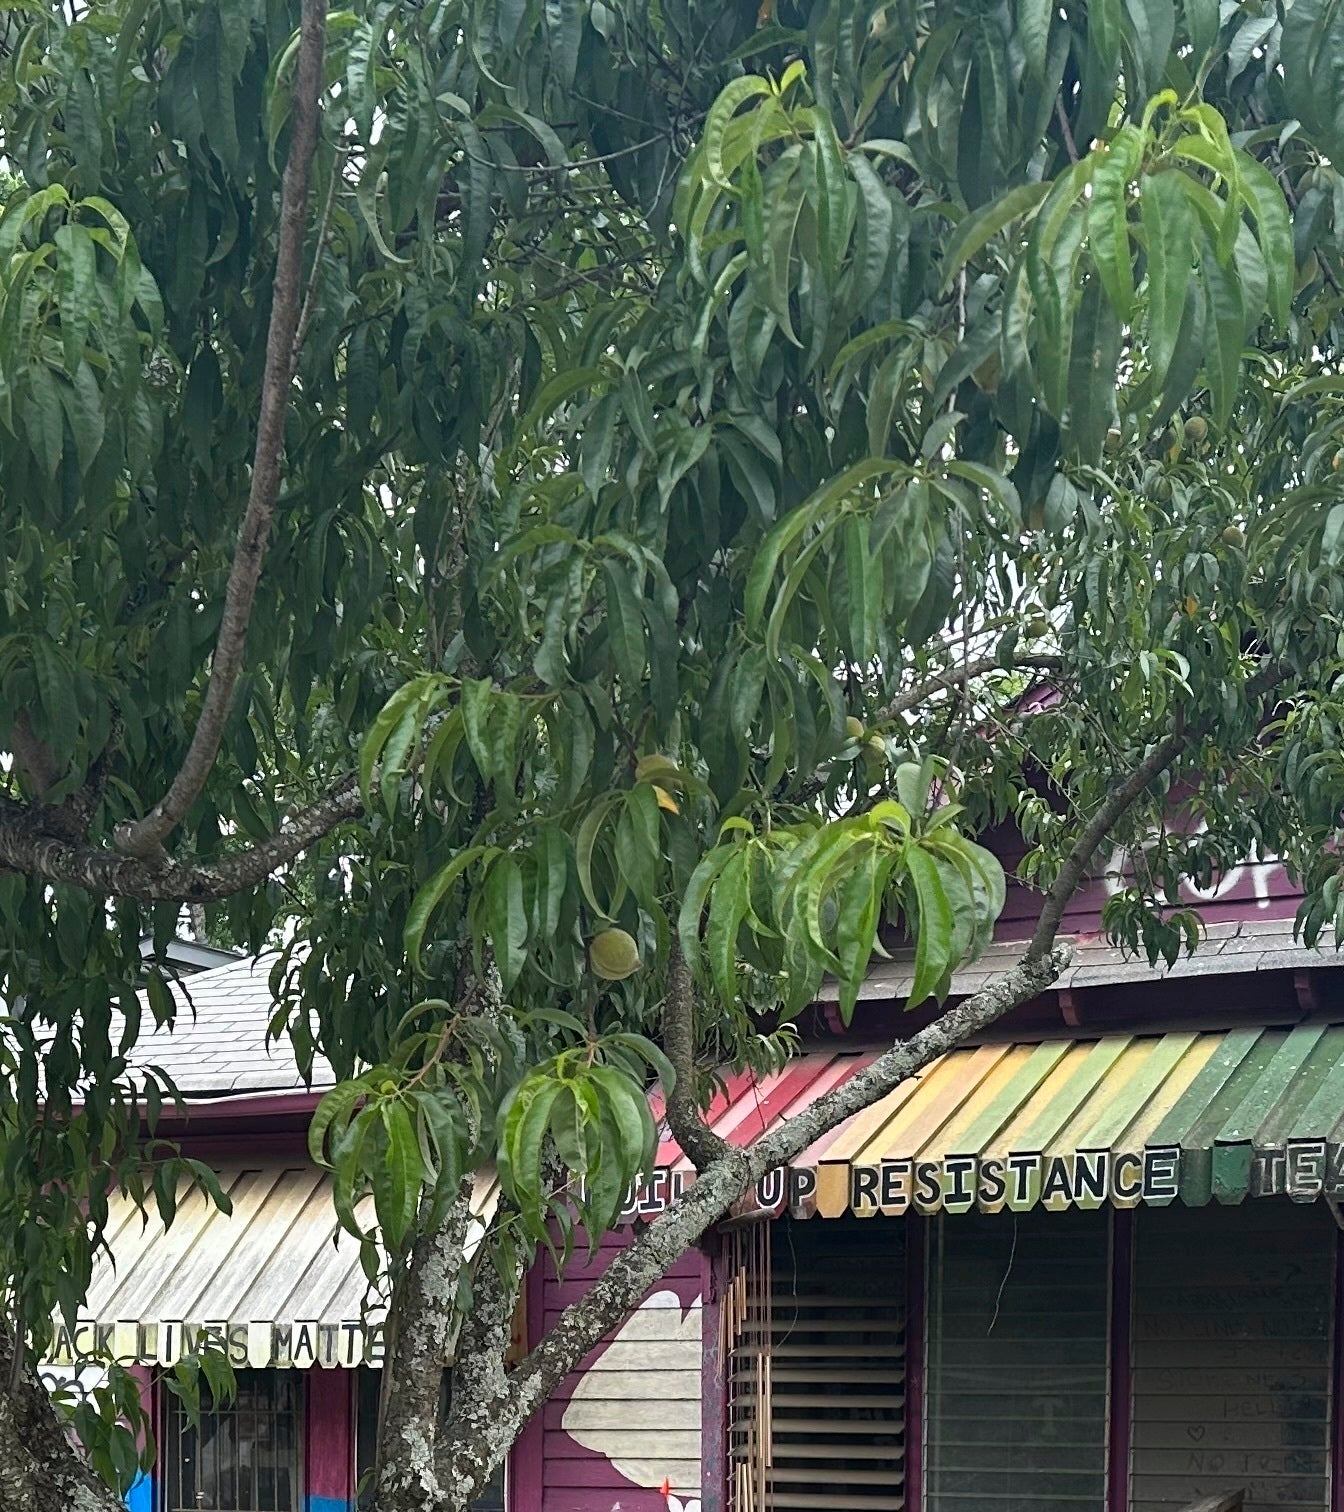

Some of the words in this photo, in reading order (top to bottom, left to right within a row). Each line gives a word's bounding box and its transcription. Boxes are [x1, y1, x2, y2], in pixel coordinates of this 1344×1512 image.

[756, 1166, 816, 1210] UP
[853, 1144, 1182, 1211] RESISTANCE
[274, 1324, 385, 1364] MATTE
